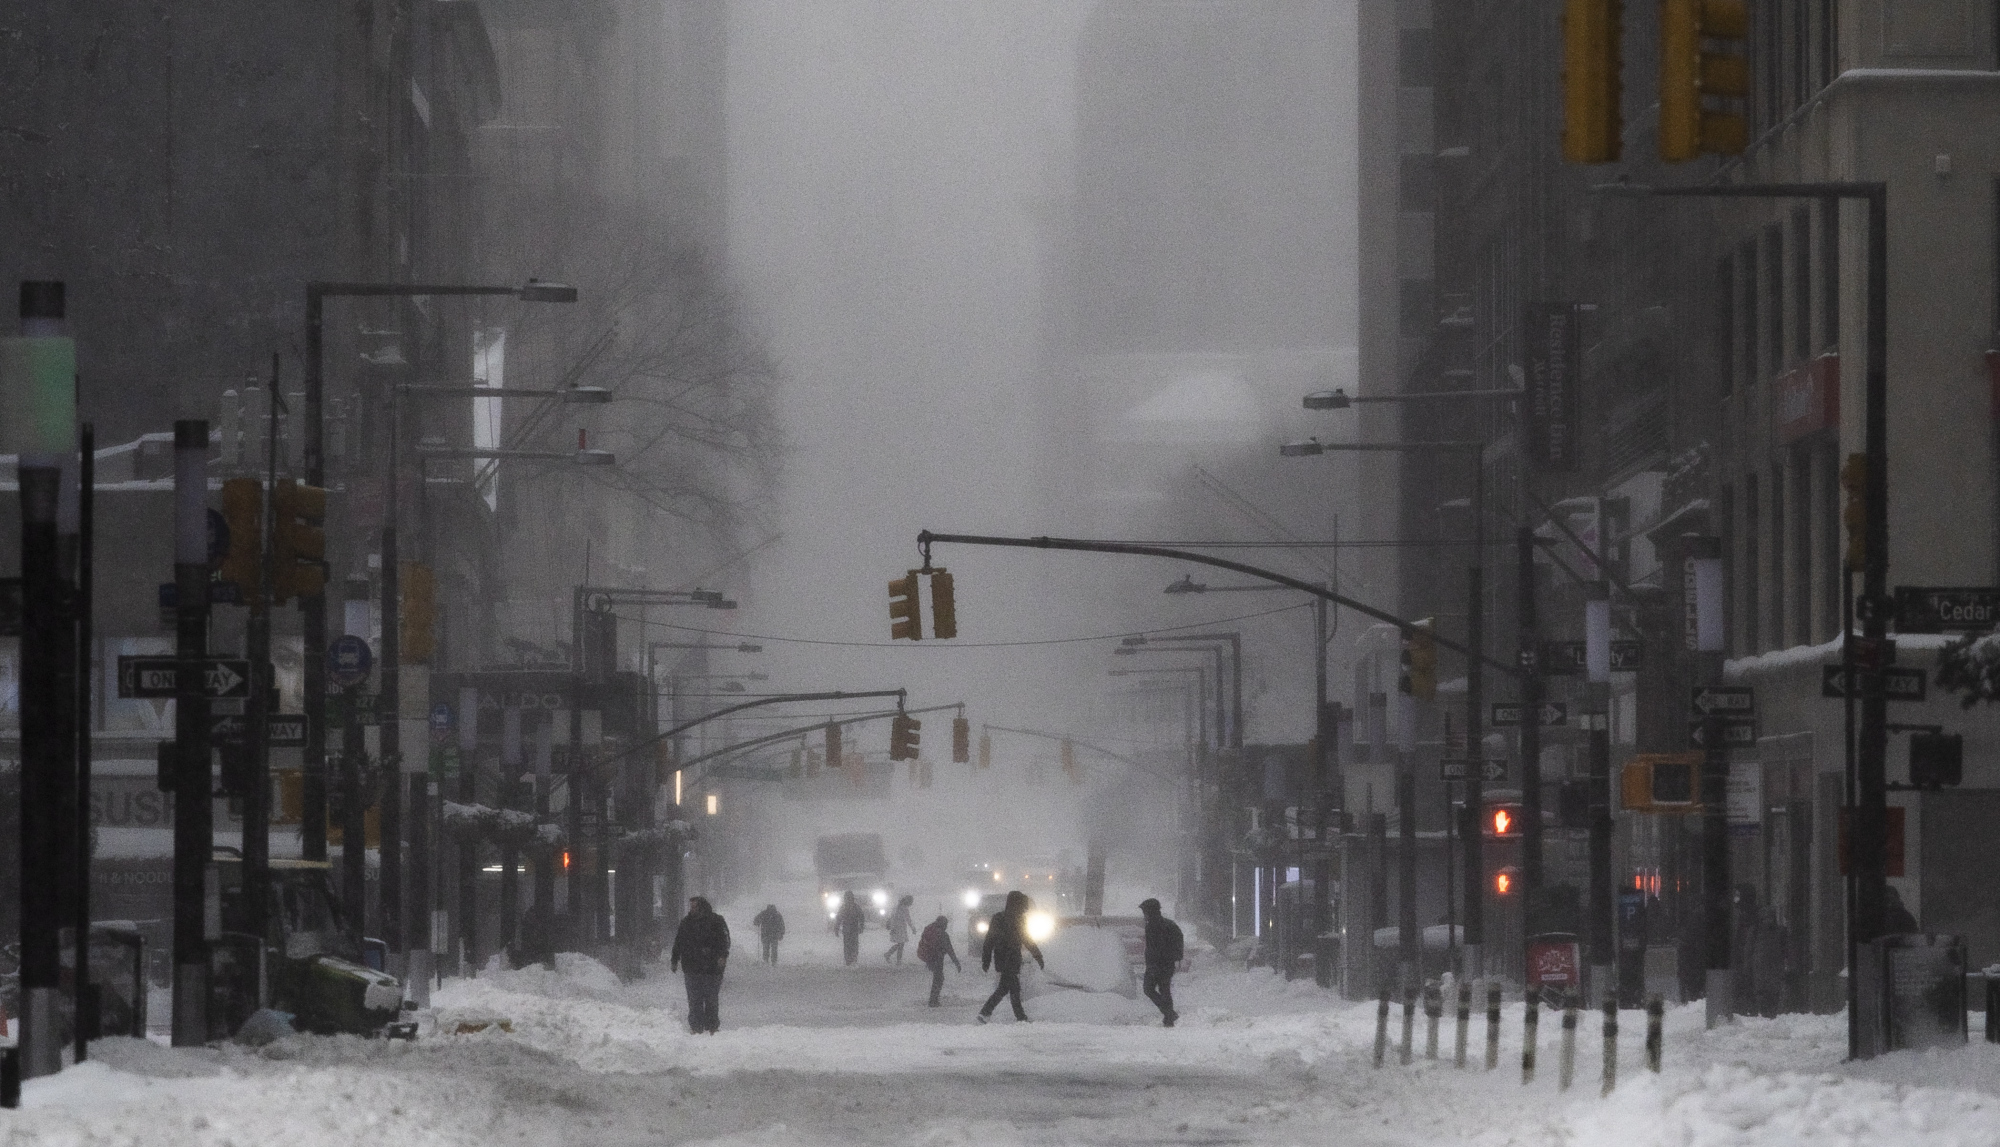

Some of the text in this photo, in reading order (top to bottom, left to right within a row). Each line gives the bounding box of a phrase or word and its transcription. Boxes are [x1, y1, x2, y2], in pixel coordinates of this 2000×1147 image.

[1549, 314, 1566, 459] Residence Inn
[1940, 601, 1992, 620] Cedar
